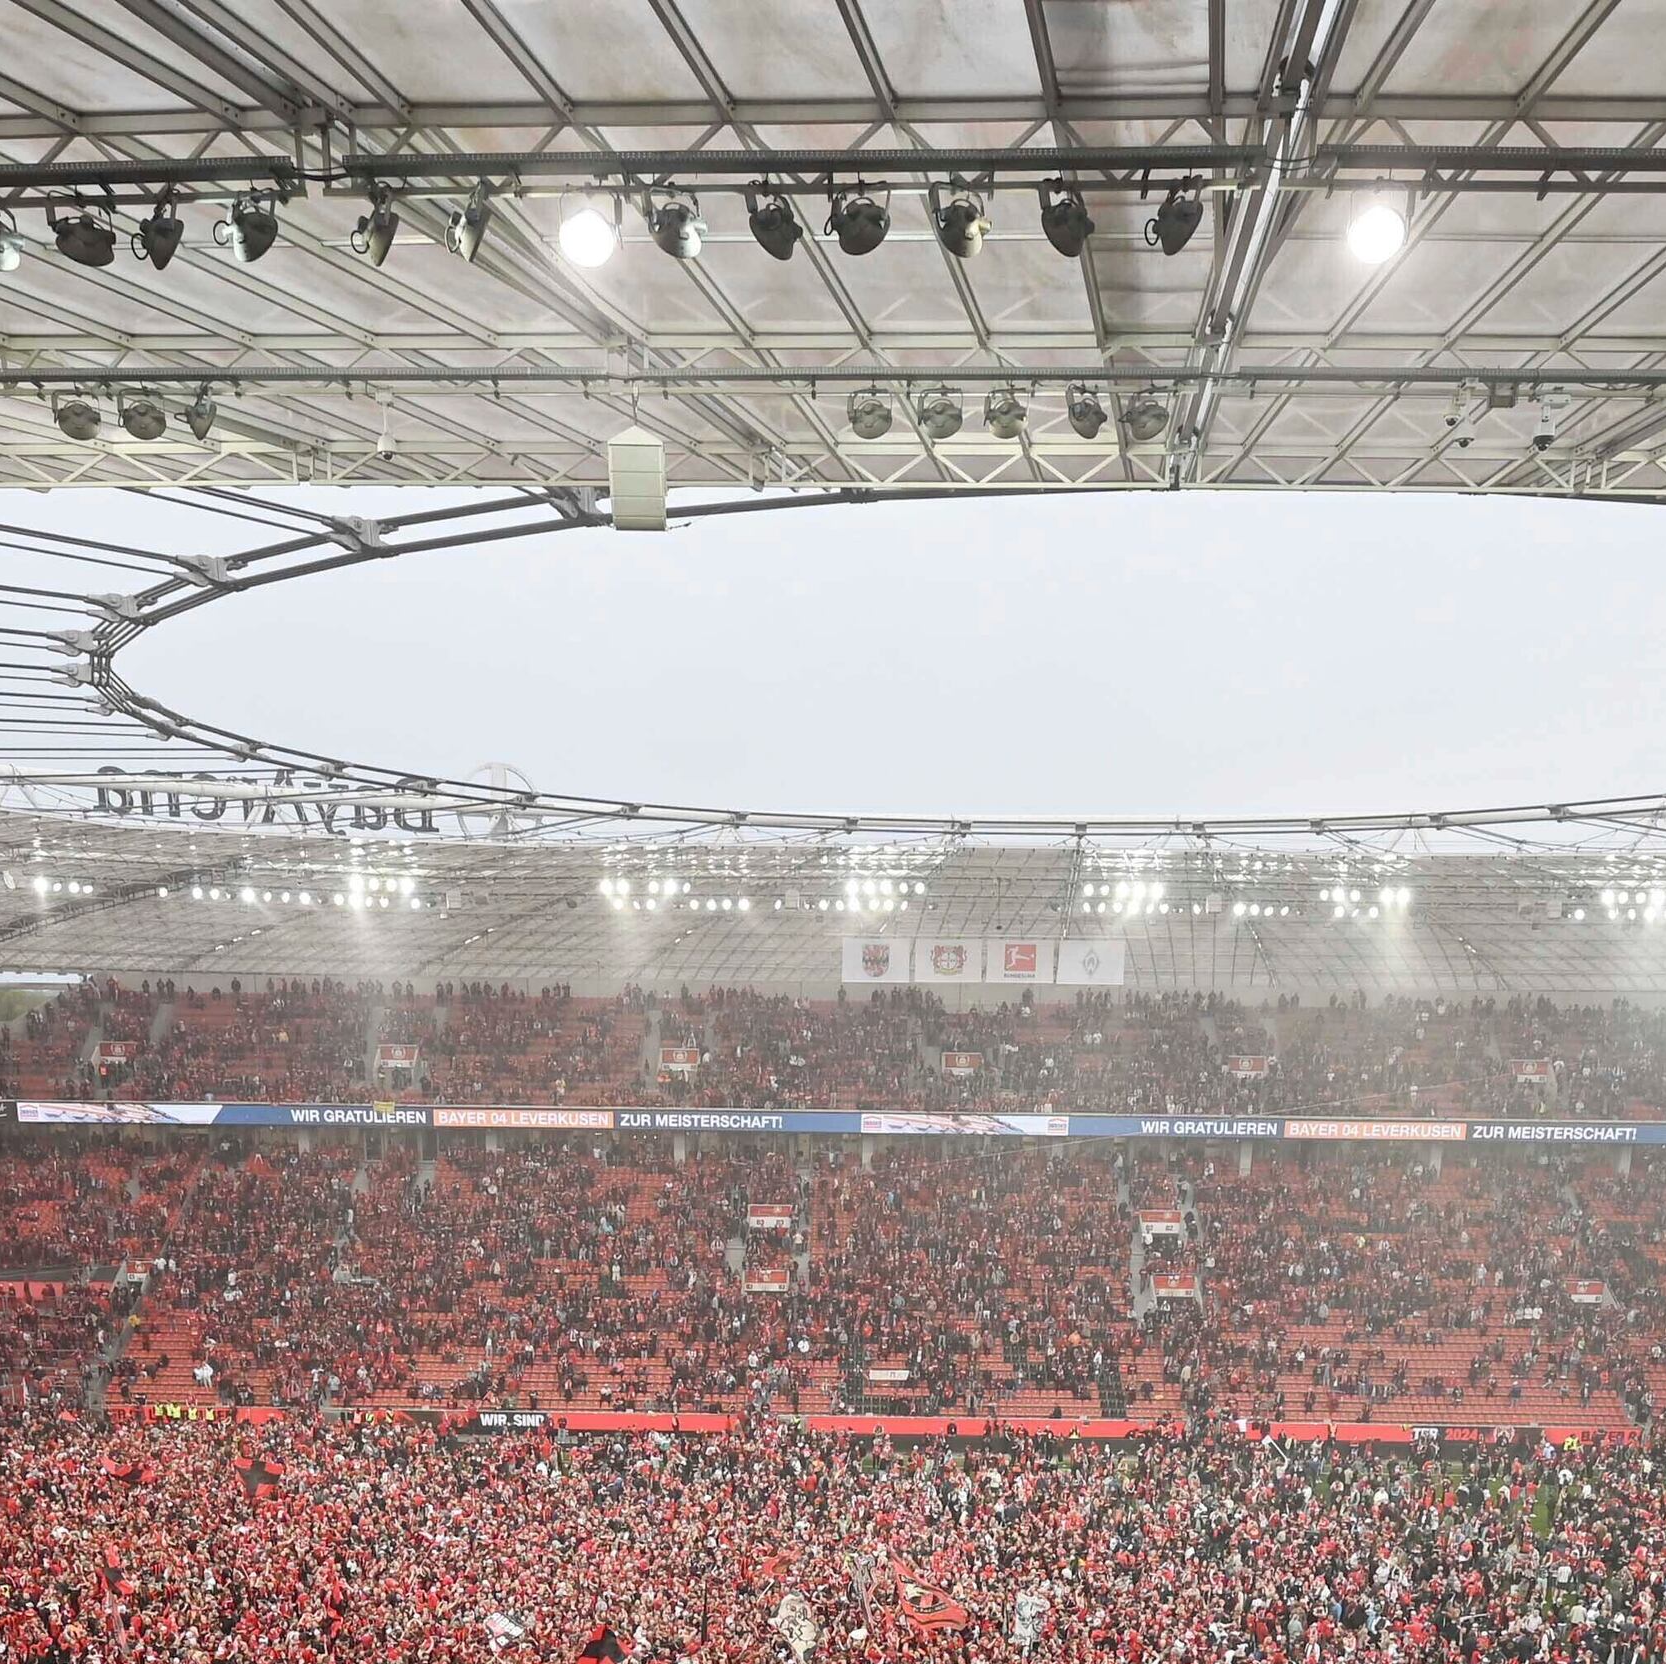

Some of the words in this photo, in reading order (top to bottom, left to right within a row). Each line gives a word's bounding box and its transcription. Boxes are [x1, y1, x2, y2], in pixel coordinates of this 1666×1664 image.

[291, 1109, 321, 1123] WIR
[323, 1108, 427, 1124] GRATULIEREN
[438, 1111, 487, 1126] BAYER
[490, 1112, 508, 1126] 04
[511, 1112, 610, 1127] LEVERKUSEN
[620, 1113, 652, 1128] ZUR
[654, 1113, 783, 1129] MEISTERSCHAFT!
[1141, 1120, 1170, 1134] WIR
[1173, 1120, 1277, 1136] GRATULIEREN
[1289, 1122, 1339, 1138] BAYER
[1341, 1123, 1359, 1138] 04
[1362, 1123, 1462, 1139] LEVERKUSEN
[1472, 1125, 1505, 1139] ZUR
[1507, 1125, 1637, 1141] MEISTERSCHAFT!
